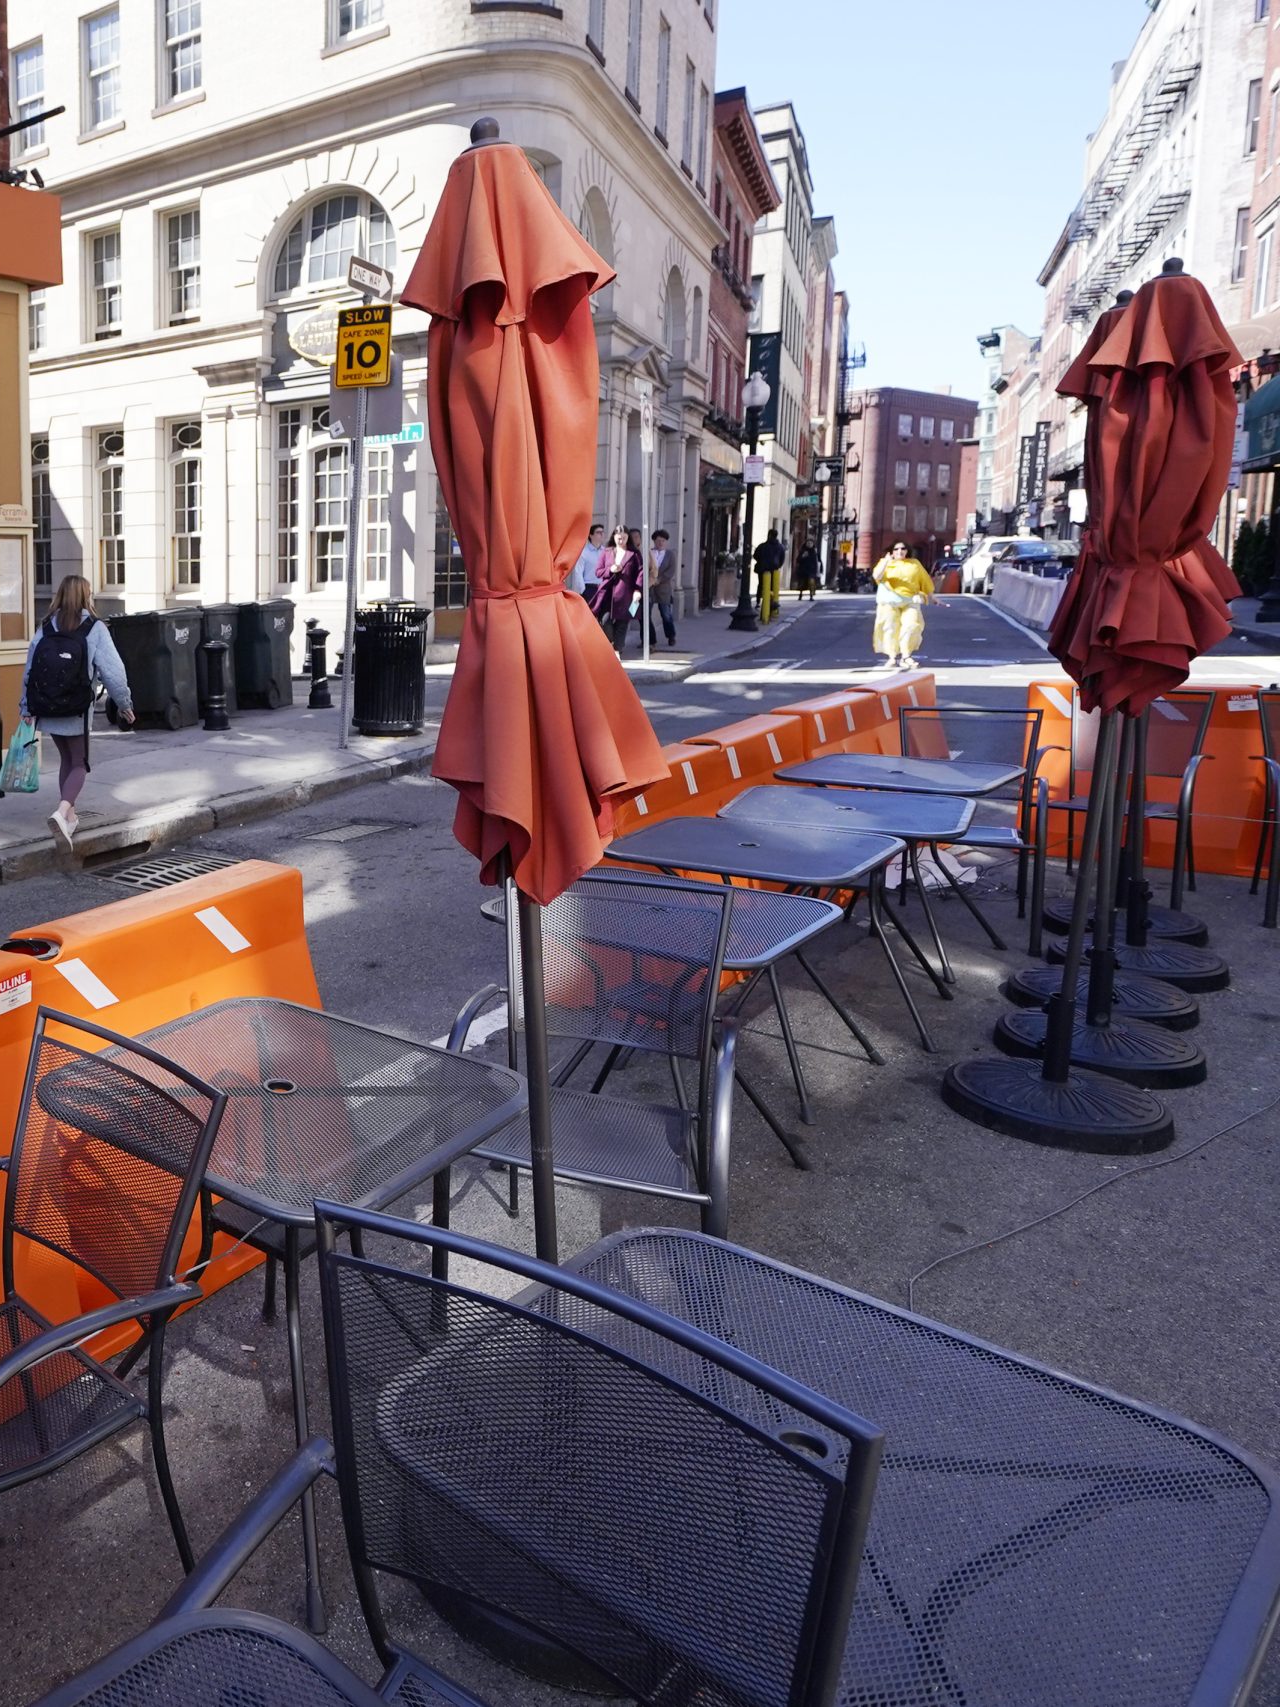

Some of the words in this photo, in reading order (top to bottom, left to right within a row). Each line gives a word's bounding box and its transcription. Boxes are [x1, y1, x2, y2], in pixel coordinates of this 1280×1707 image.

[353, 265, 367, 282] ONE
[369, 272, 382, 288] WAY
[345, 309, 384, 324] SLOW
[343, 330, 362, 339] CAFE
[364, 328, 385, 337] ZONE
[344, 340, 382, 369] 10
[342, 372, 362, 381] SPEED
[364, 371, 381, 379] LIMIT
[1020, 438, 1032, 503] LIBERTINE
[1033, 424, 1048, 498] LIBERTINE
[404, 624, 420, 632] Trash
[0, 972, 27, 992] ULINE
